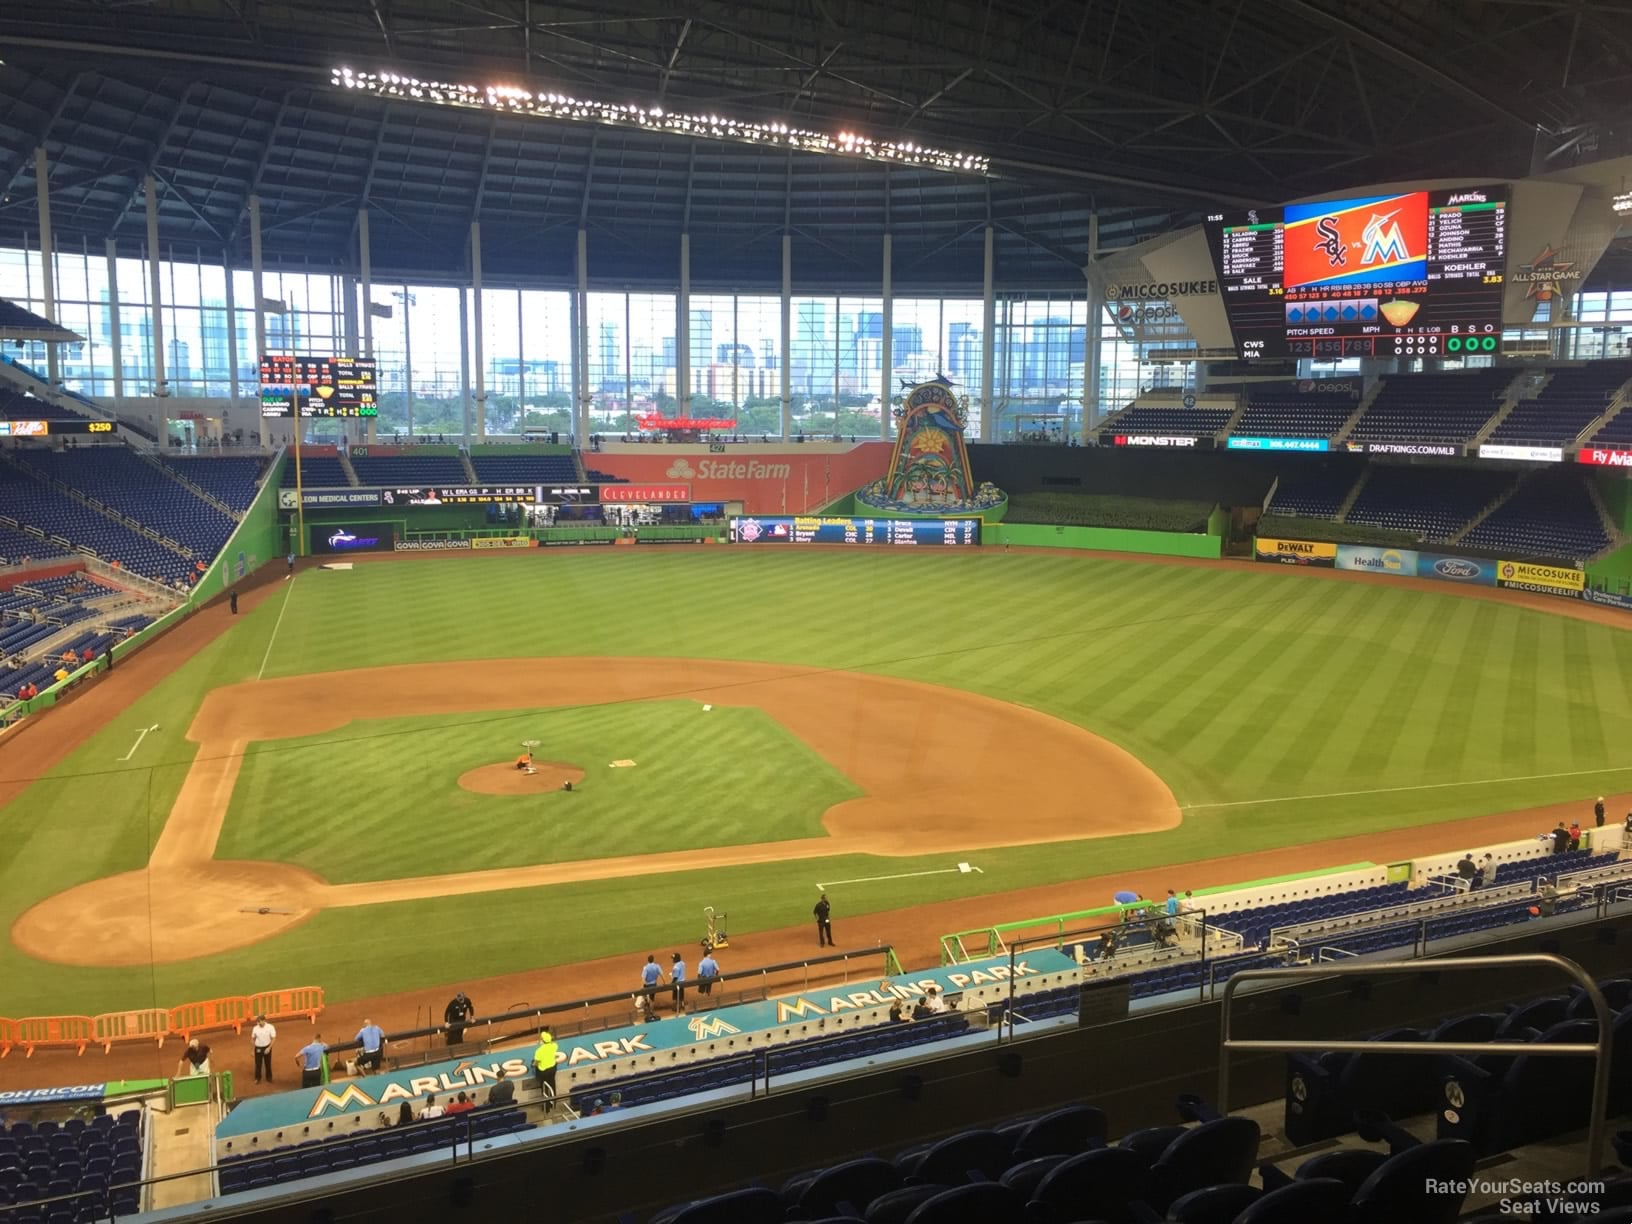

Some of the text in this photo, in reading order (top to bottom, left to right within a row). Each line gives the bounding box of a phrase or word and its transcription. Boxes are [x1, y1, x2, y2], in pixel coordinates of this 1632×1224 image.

[1448, 191, 1486, 205] MARLINS
[1444, 263, 1486, 271] KOEHLER
[1531, 272, 1551, 281] STAR
[1553, 271, 1580, 280] GAME
[1121, 281, 1216, 298] MICCOSUKEE
[1136, 305, 1175, 322] pepsi
[1451, 324, 1493, 333] B S O
[1318, 382, 1352, 392] pepsi
[89, 423, 112, 432] $250
[1128, 436, 1194, 446] MONSTER
[1369, 444, 1455, 455] DRAFTKINGS.COM/MLB
[1593, 450, 1608, 464] Fly
[604, 488, 686, 500] CLEVELANDER
[1277, 542, 1314, 553] DEWALT
[1442, 560, 1471, 577] Ford
[1518, 566, 1580, 581] MICCOSUKEE
[1504, 581, 1579, 597] #MICCOSUKEELIFE
[778, 960, 1040, 1024] MARLINS PARK
[33, 1084, 104, 1096] RICOH
[308, 1059, 528, 1119] MARLINS
